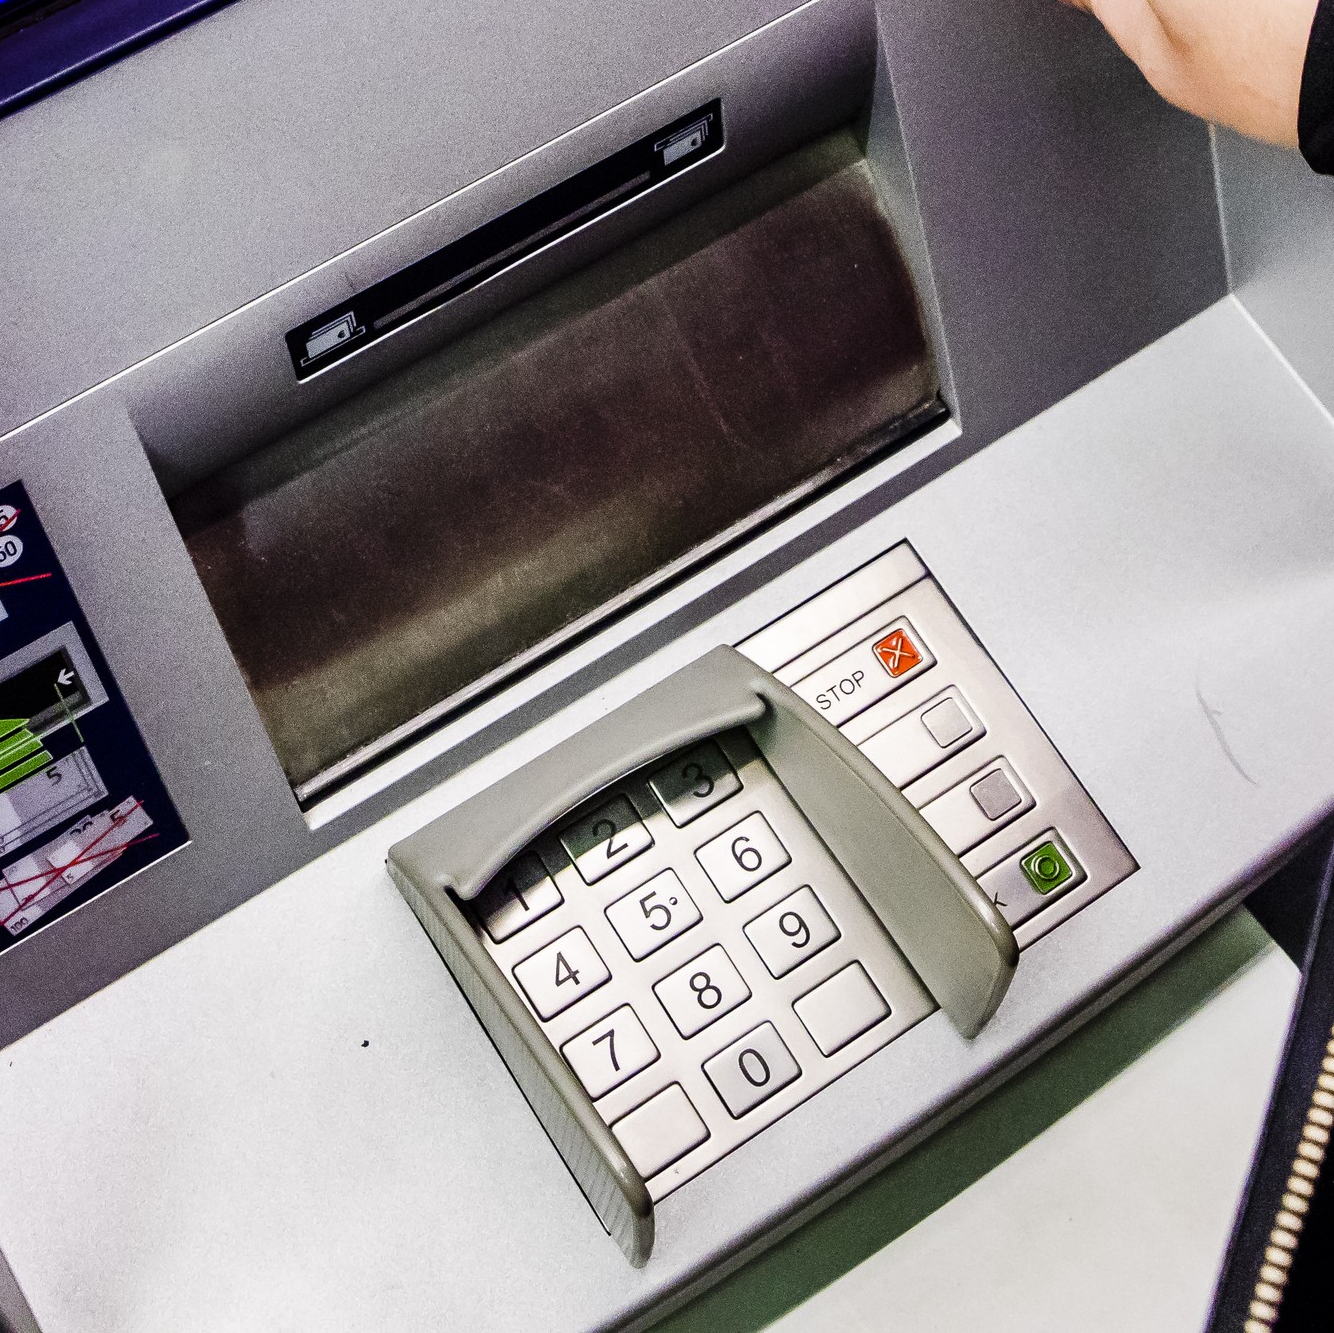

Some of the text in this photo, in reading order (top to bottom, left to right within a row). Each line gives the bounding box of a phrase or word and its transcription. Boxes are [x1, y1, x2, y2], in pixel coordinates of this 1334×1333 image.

[816, 670, 865, 710] STOP
[45, 766, 63, 787] 5
[681, 762, 715, 798] 3
[592, 818, 629, 859] 2
[731, 836, 763, 872] 6
[638, 891, 672, 931] 5
[778, 911, 811, 949] 9
[555, 951, 581, 987] 4
[689, 971, 723, 1010] 8
[591, 1028, 621, 1072] 7
[738, 1048, 771, 1088] 0
